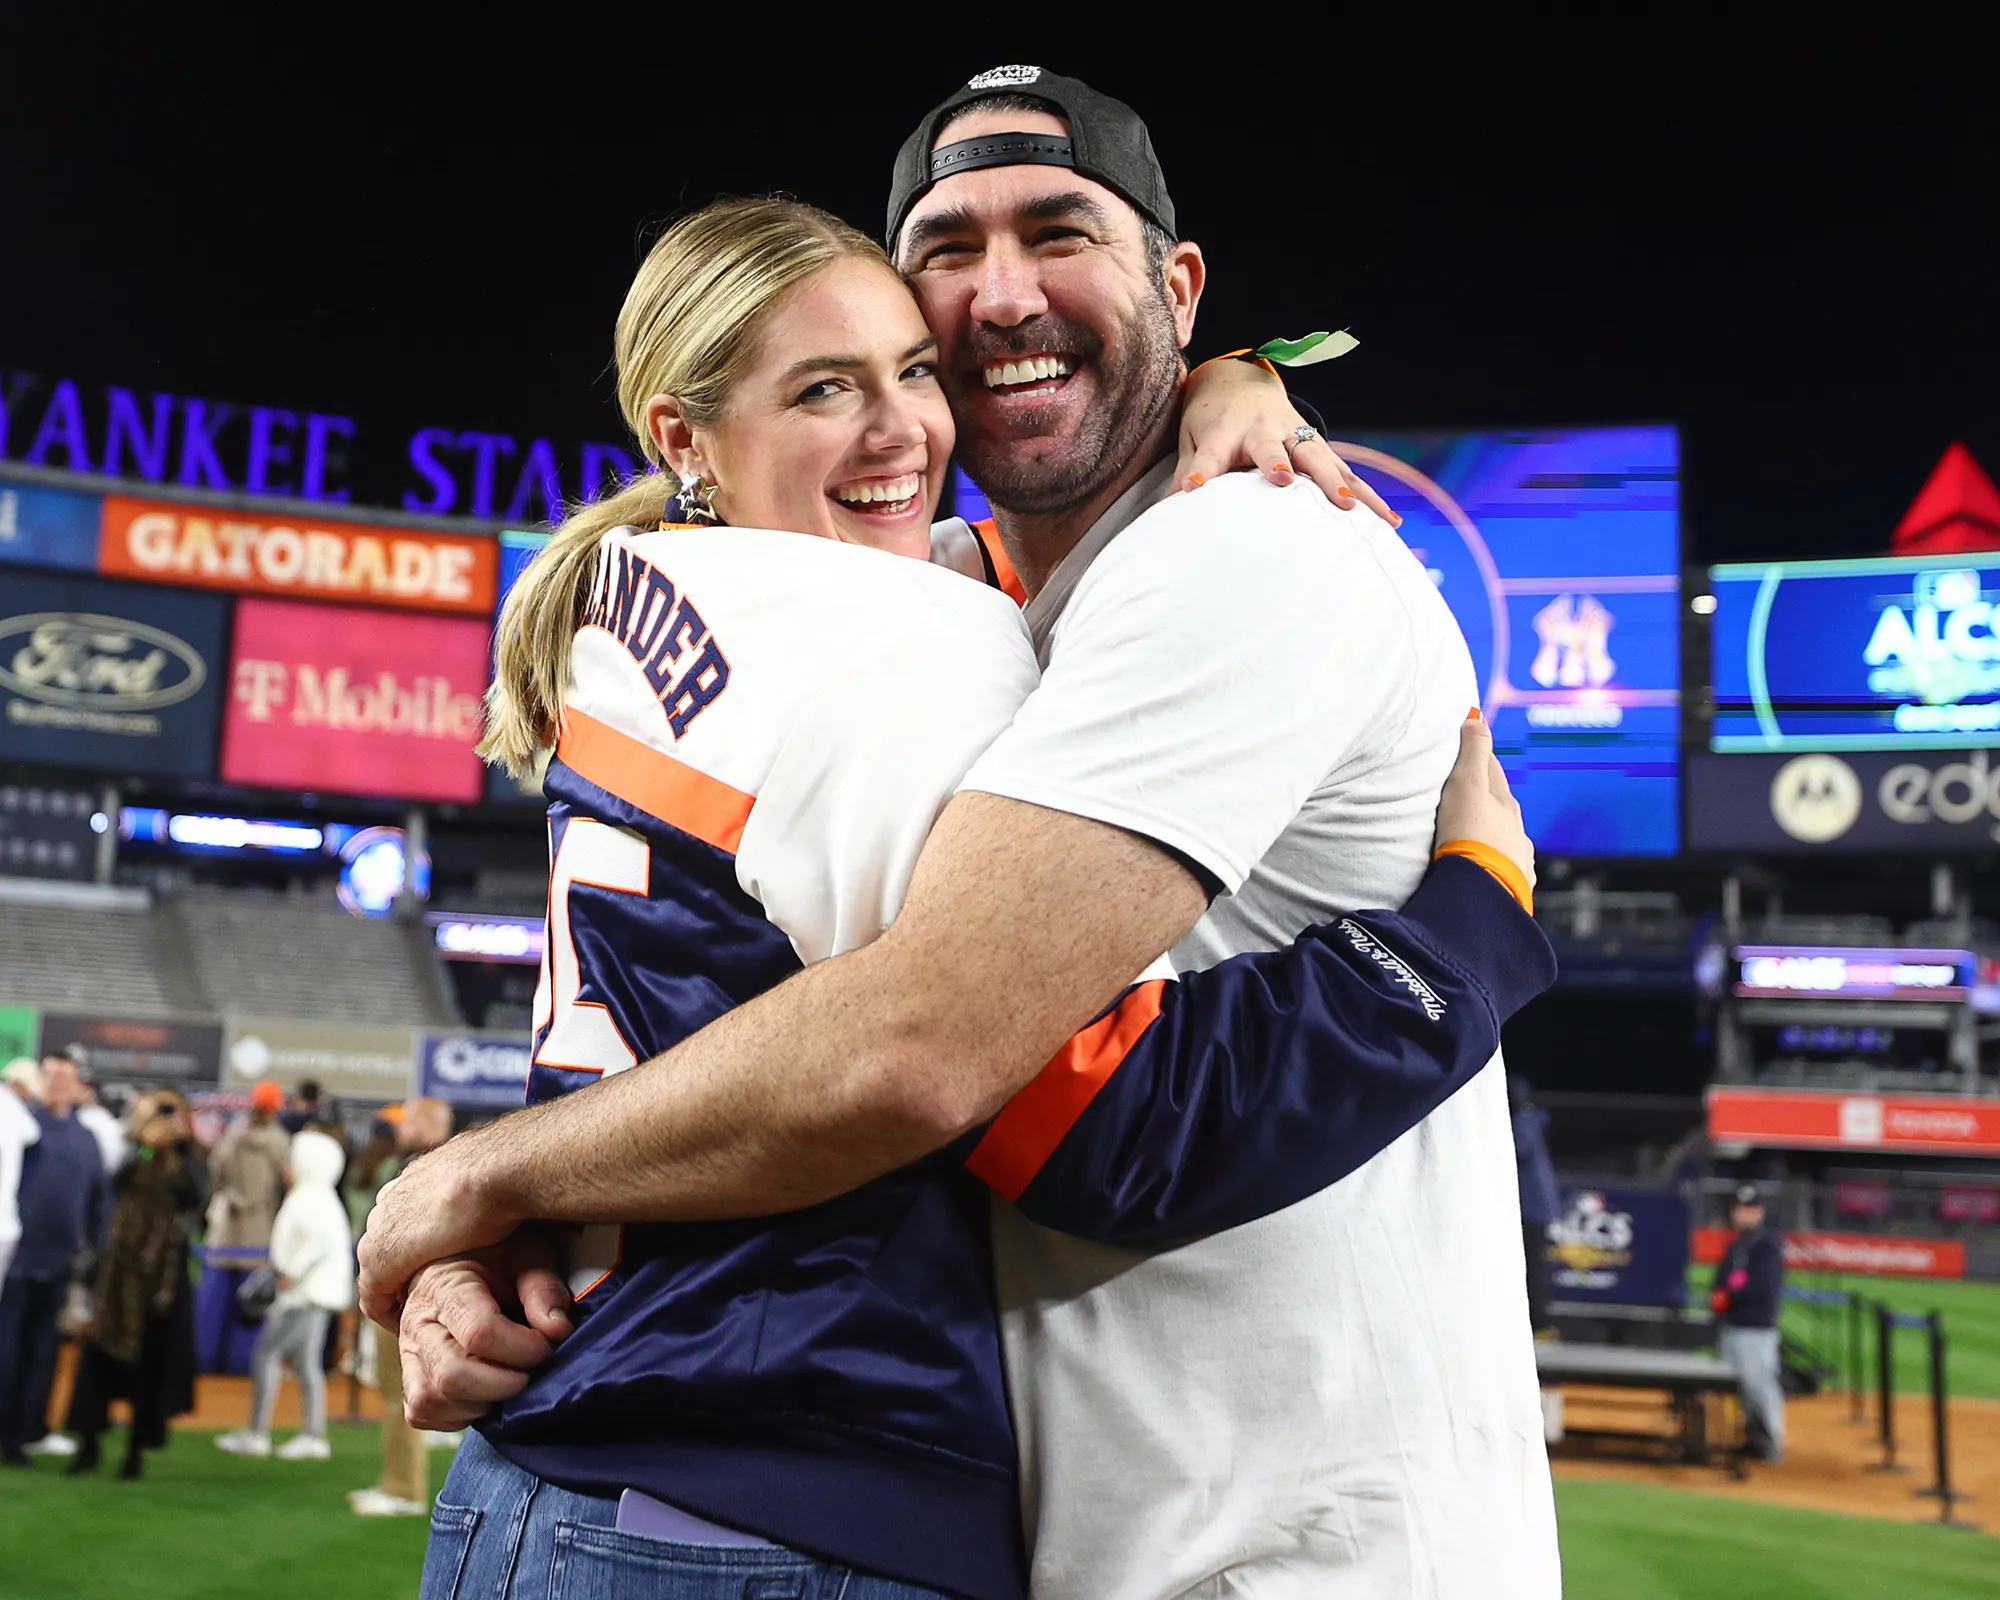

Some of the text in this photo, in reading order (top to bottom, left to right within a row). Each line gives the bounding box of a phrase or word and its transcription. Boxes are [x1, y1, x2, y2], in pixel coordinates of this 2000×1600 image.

[403, 426, 660, 528] STAD
[127, 512, 475, 602] GATORADE
[12, 620, 167, 698] Ford
[1862, 601, 2000, 667] ALC
[292, 662, 479, 742] Mobile
[1877, 748, 2000, 845] ed
[1338, 919, 1446, 1021] Mitchell & Ness
